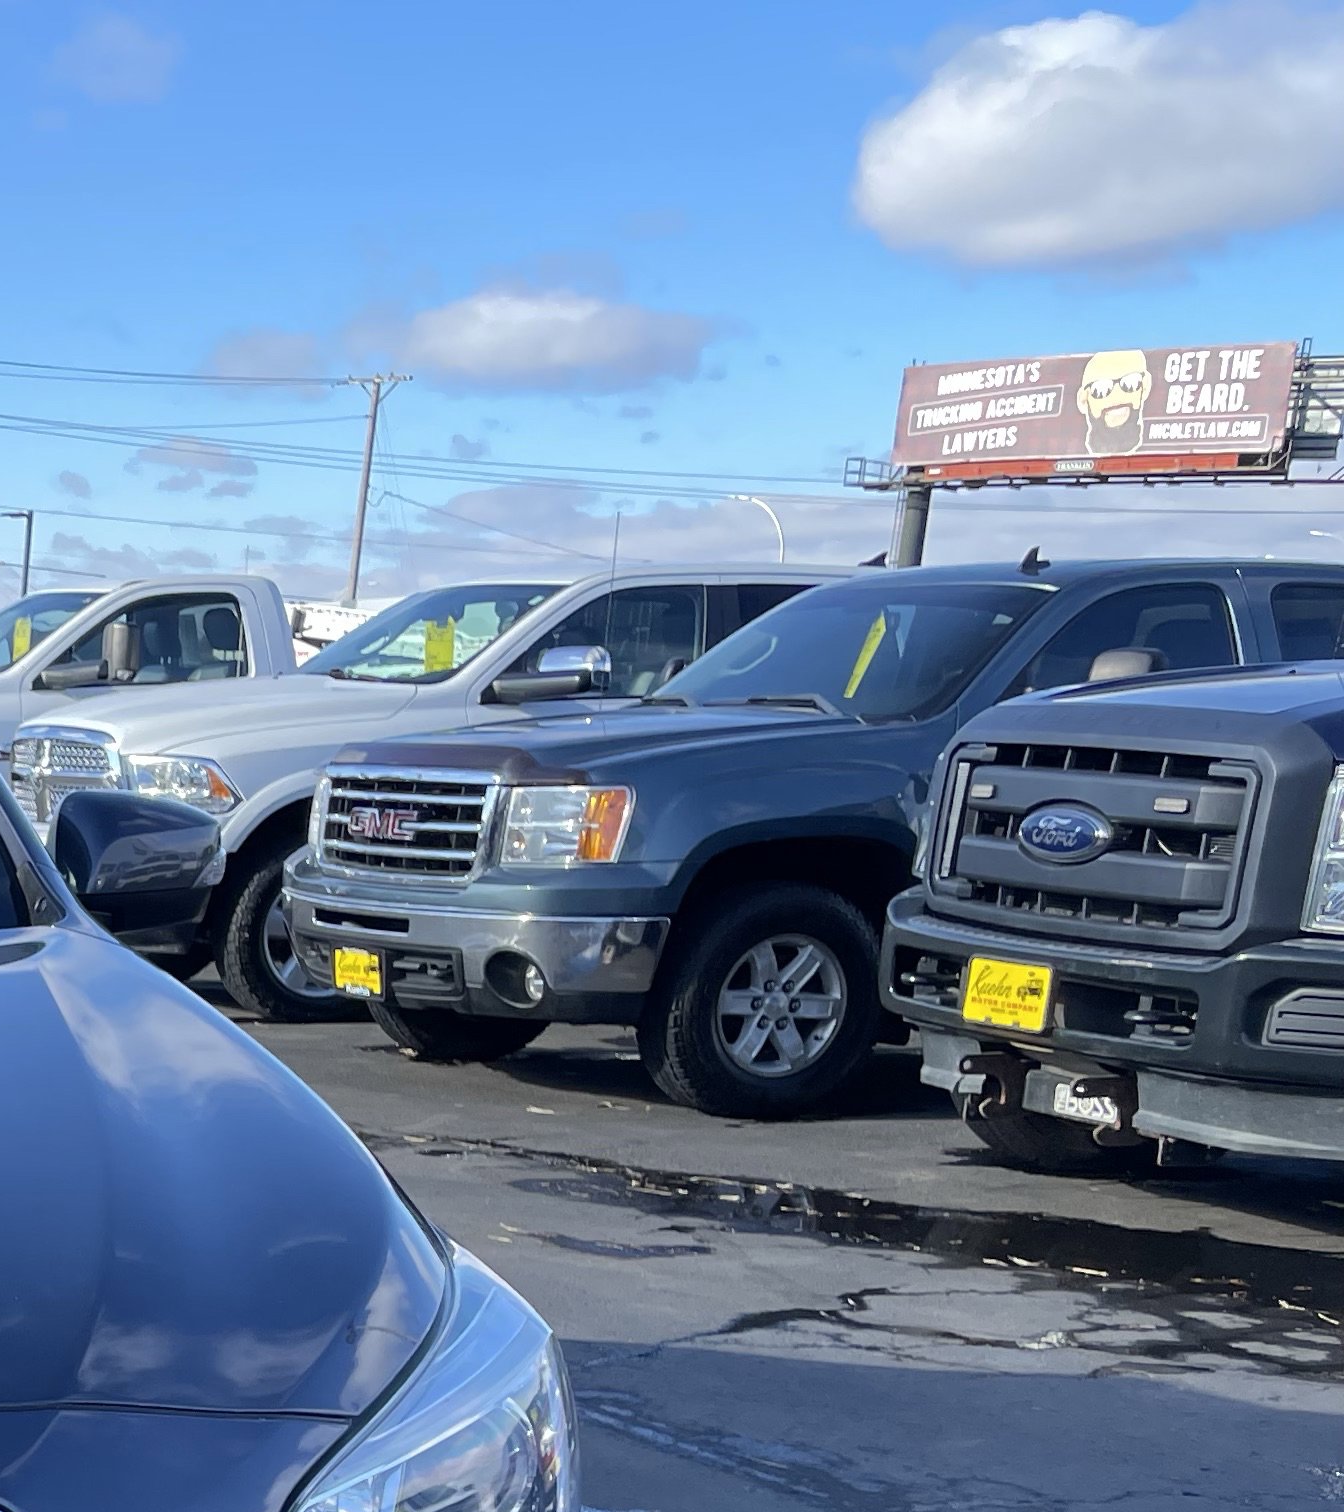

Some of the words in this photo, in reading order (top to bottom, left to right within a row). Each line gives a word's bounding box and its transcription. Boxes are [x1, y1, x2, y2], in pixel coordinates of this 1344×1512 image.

[937, 361, 1041, 396] MINNESOTA'S
[1164, 350, 1211, 383] GET
[1218, 349, 1265, 381] THE
[916, 401, 983, 429] TRUCKING
[985, 392, 1057, 419] ACCIDENT
[1165, 382, 1250, 414] BEARD.
[942, 426, 1018, 455] LAWYERS
[1148, 420, 1262, 440] NICOLETLAW.COM
[347, 806, 418, 841] GMC
[1032, 815, 1082, 848] Ford
[971, 965, 1013, 1000] Kuehn
